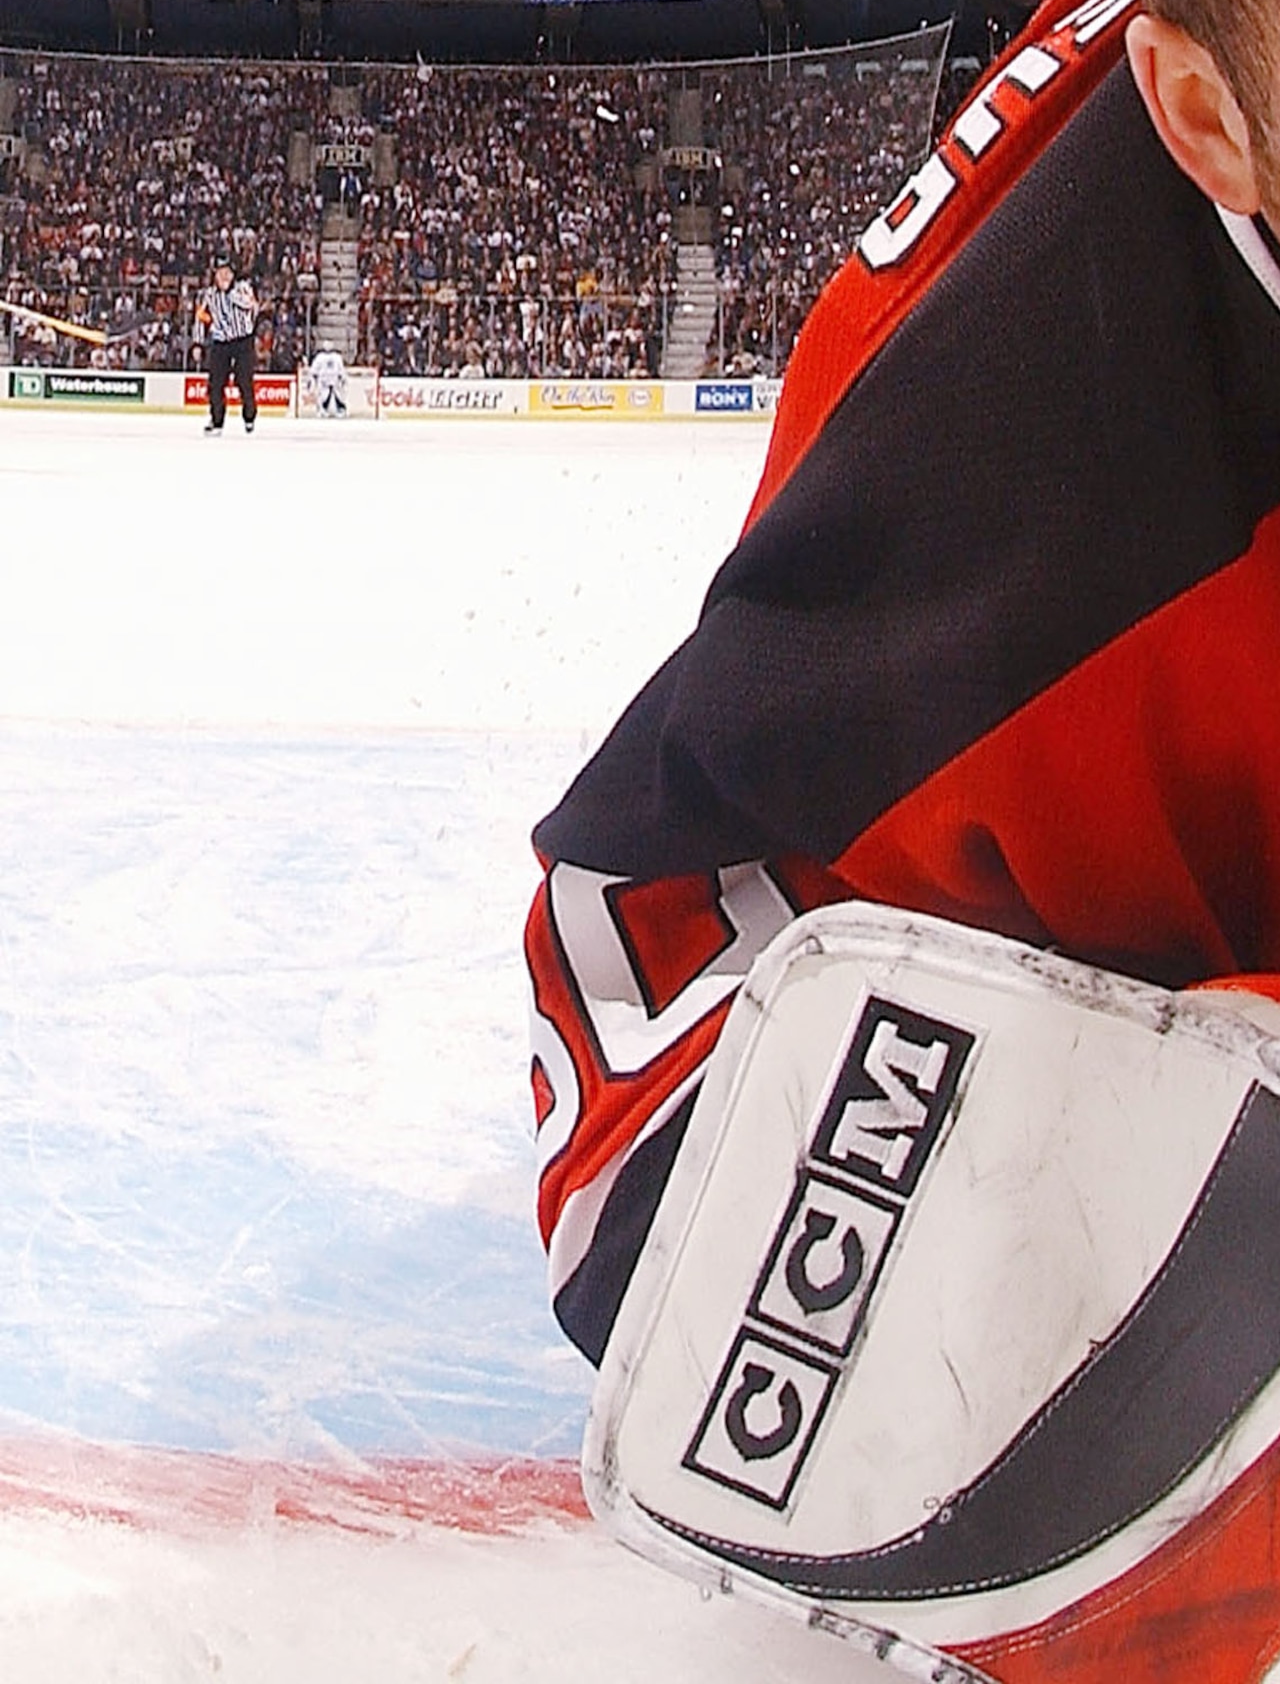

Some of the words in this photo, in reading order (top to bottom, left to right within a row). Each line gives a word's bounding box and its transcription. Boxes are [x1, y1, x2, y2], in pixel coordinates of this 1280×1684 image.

[51, 376, 139, 395] Waterhouse
[428, 389, 503, 409] LIGHT
[714, 1013, 956, 1468] CCM
